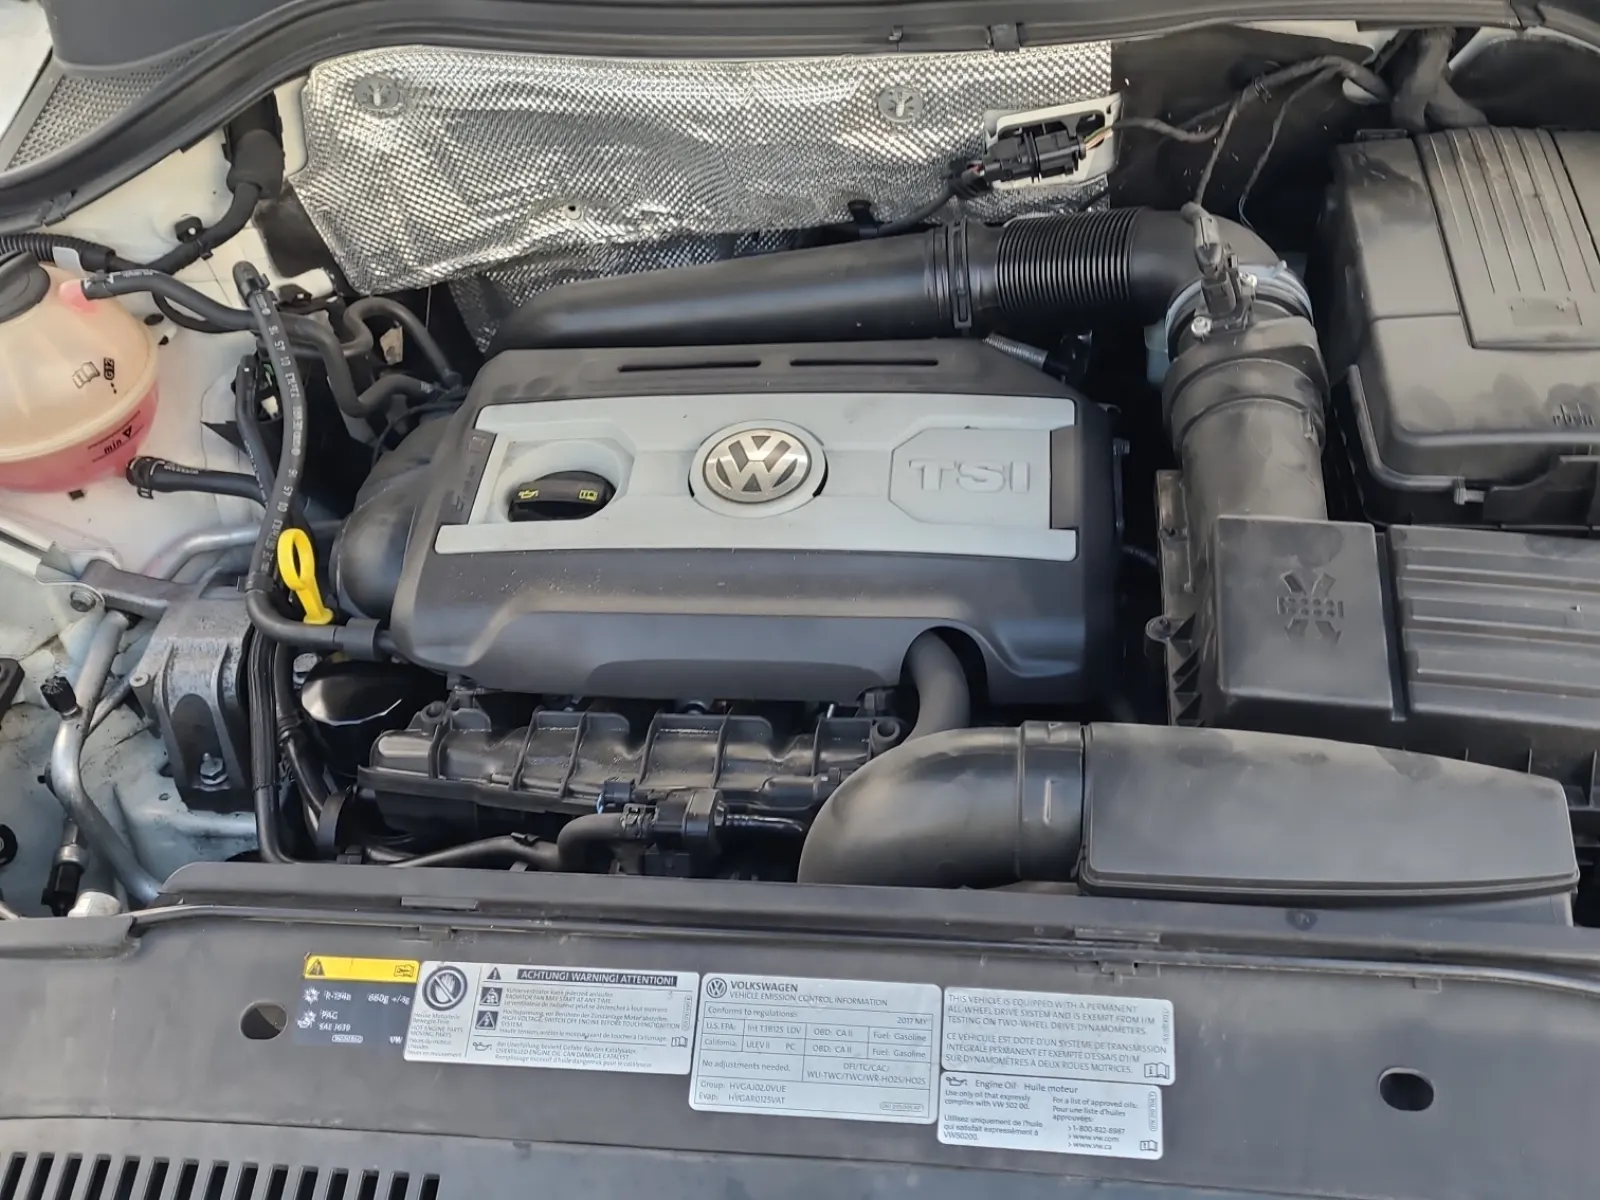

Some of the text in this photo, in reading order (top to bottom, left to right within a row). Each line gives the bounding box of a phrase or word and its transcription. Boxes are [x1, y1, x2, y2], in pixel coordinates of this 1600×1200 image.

[104, 439, 122, 454] min
[703, 428, 813, 504] VW
[909, 460, 1031, 492] TSI
[520, 970, 674, 985] ACHTUNG! WARNING! ATTENTION!
[730, 981, 799, 992] VOLKSWAGEN
[729, 991, 888, 1006] VEHICLE EMISSION CONTROL INFORMATION
[948, 995, 967, 1003] THIS
[968, 996, 1002, 1005] VEHICLE
[1013, 998, 1053, 1008] EQUIPPED
[1087, 1003, 1138, 1012] PERMANENT
[320, 1010, 338, 1019] PAG
[708, 1006, 742, 1015] Conforms
[994, 1008, 1018, 1016] DRIVE
[1020, 1010, 1051, 1018] SYSTEM
[1052, 1011, 1072, 1019] AND
[1082, 1013, 1114, 1021] EXEMPT
[1116, 1015, 1140, 1023] FROM
[897, 1016, 913, 1024] 2017
[948, 1016, 981, 1025] TESTING
[982, 1018, 996, 1026] ON
[998, 1019, 1049, 1029] TWO-WHEEL
[1051, 1022, 1075, 1030] DRIVE
[894, 1033, 927, 1042] Gasoline
[834, 1045, 846, 1053] CA
[893, 1049, 926, 1058] Gasoline
[989, 1046, 1036, 1056] PERMANENT
[1107, 1043, 1167, 1053] TRANSMISSION
[702, 1059, 713, 1067] No
[714, 1060, 760, 1070] adjustments
[945, 1054, 962, 1062] SUR
[1038, 1060, 1060, 1068] DEUX
[1062, 1061, 1090, 1070] ROUES
[975, 1080, 1078, 1094] Engine Oil Huile moteur
[959, 1090, 974, 1099] only
[999, 1094, 1031, 1102] expressly
[944, 1098, 974, 1107] complies
[975, 1099, 992, 1107] with
[1090, 1100, 1123, 1108] approved
[944, 1114, 969, 1122] Utilisez
[970, 1116, 1011, 1125] uniquement
[955, 1124, 982, 1132] satisfait
[983, 1126, 1031, 1136] expressément
